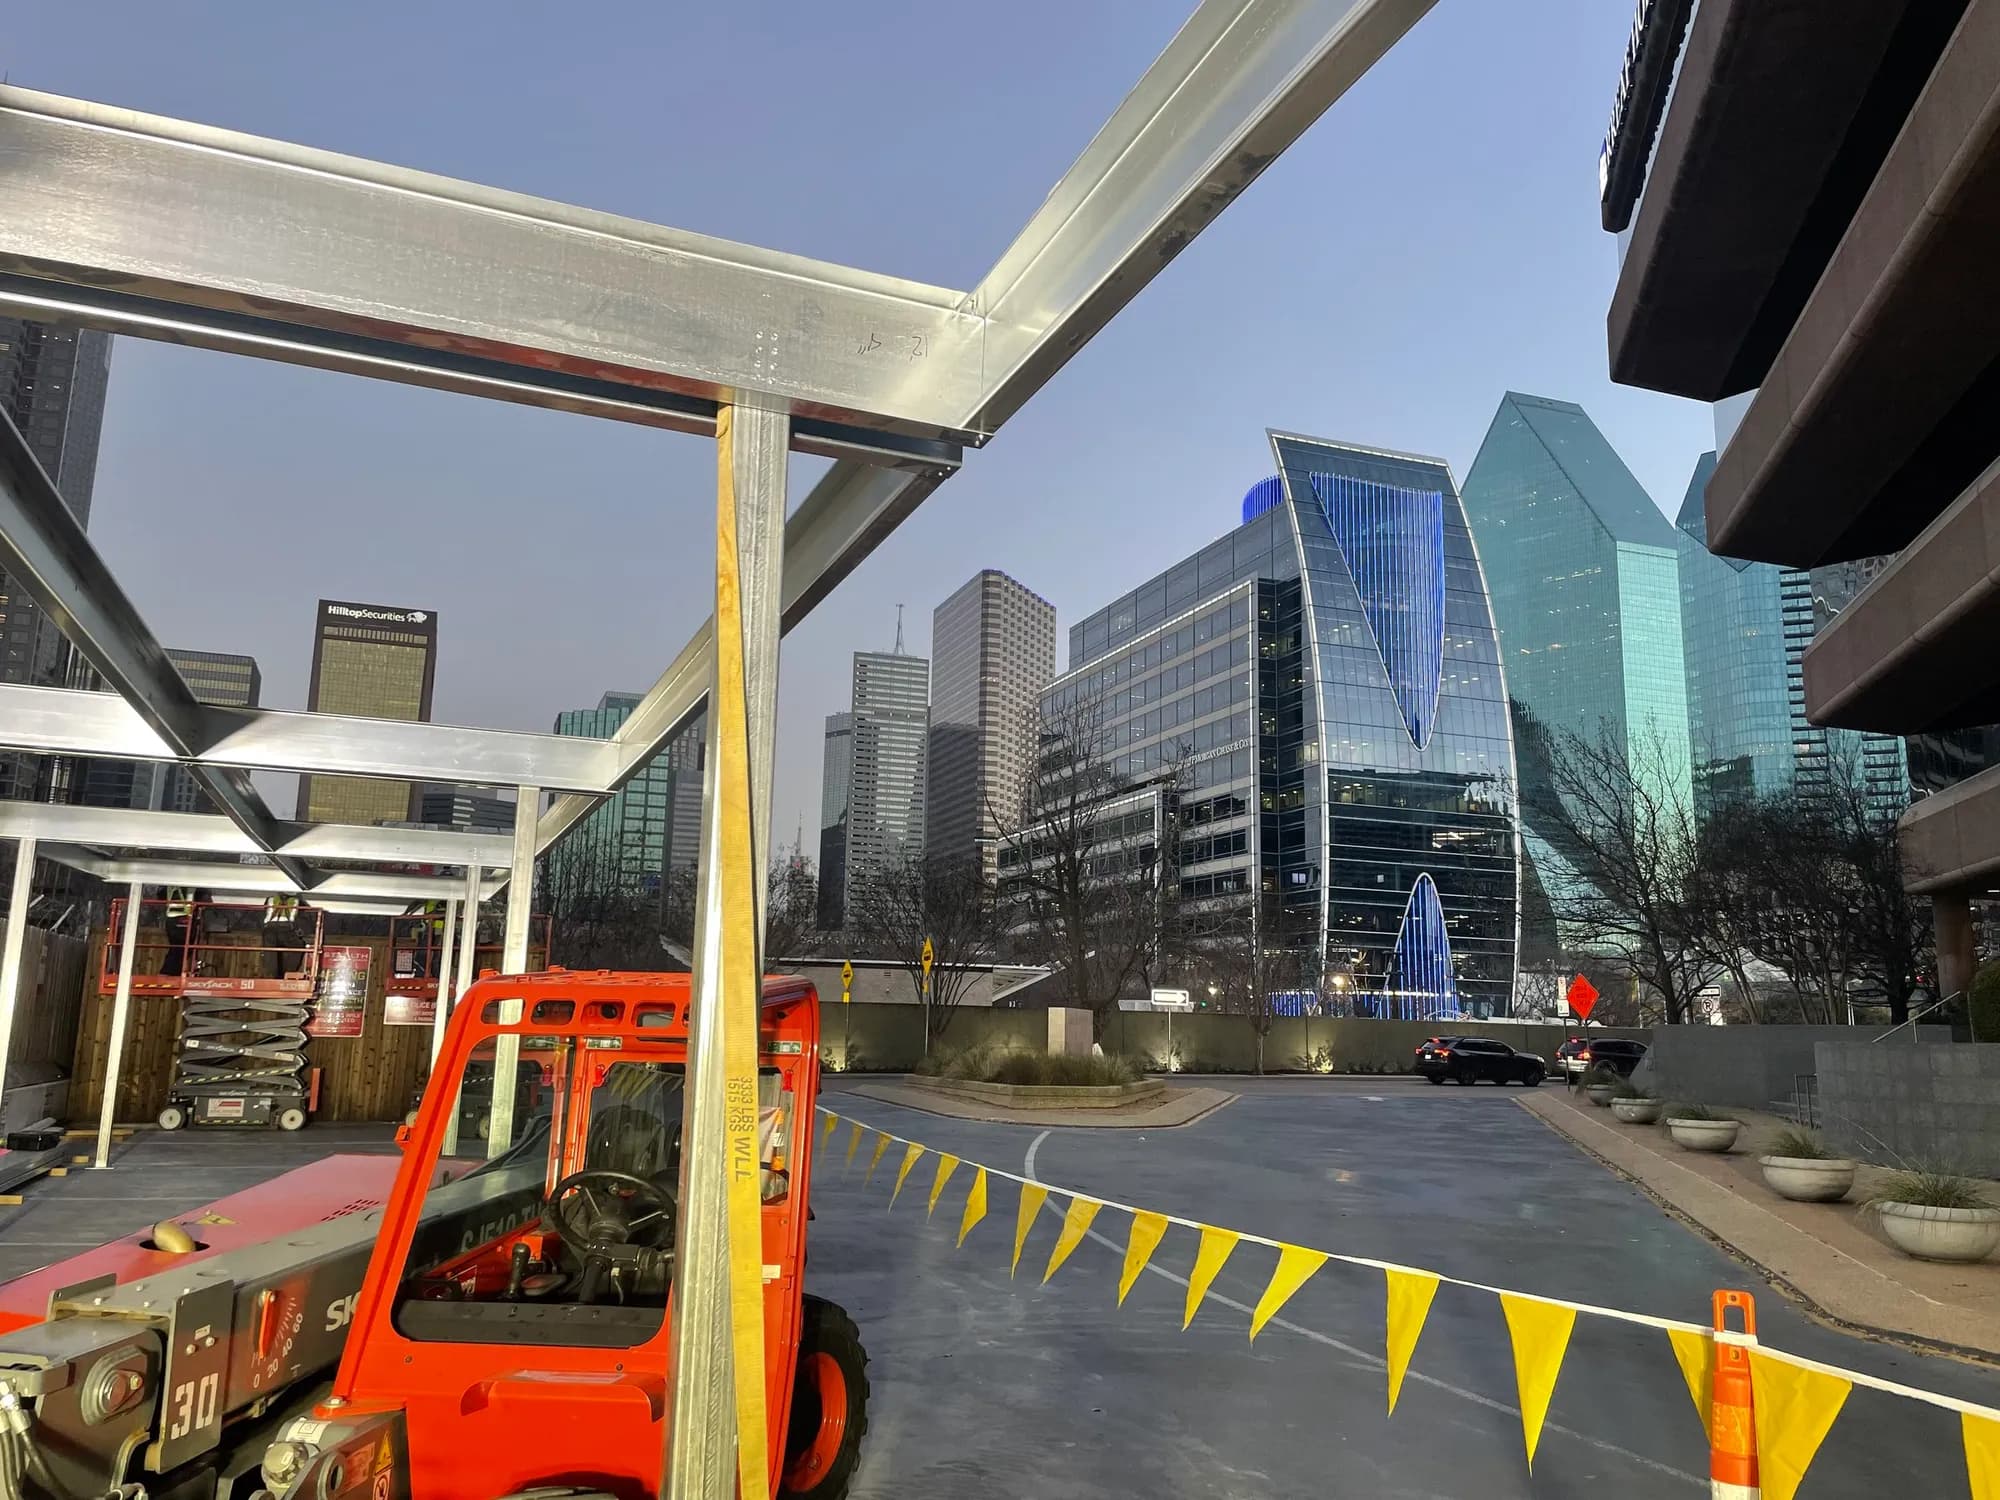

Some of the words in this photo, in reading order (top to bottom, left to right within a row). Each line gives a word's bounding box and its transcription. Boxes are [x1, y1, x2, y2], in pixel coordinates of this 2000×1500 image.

[327, 605, 405, 622] HilltopSecurities
[239, 979, 255, 989] 50
[728, 1077, 740, 1103] 1515
[740, 1076, 753, 1104] 3333
[729, 1106, 742, 1132] KGS
[741, 1107, 754, 1132] LBS
[734, 1137, 752, 1183] WLL
[292, 1312, 304, 1334] 60
[282, 1337, 293, 1359] 40
[267, 1358, 279, 1380] 20
[253, 1373, 260, 1389] 0
[170, 1372, 219, 1440] 30
